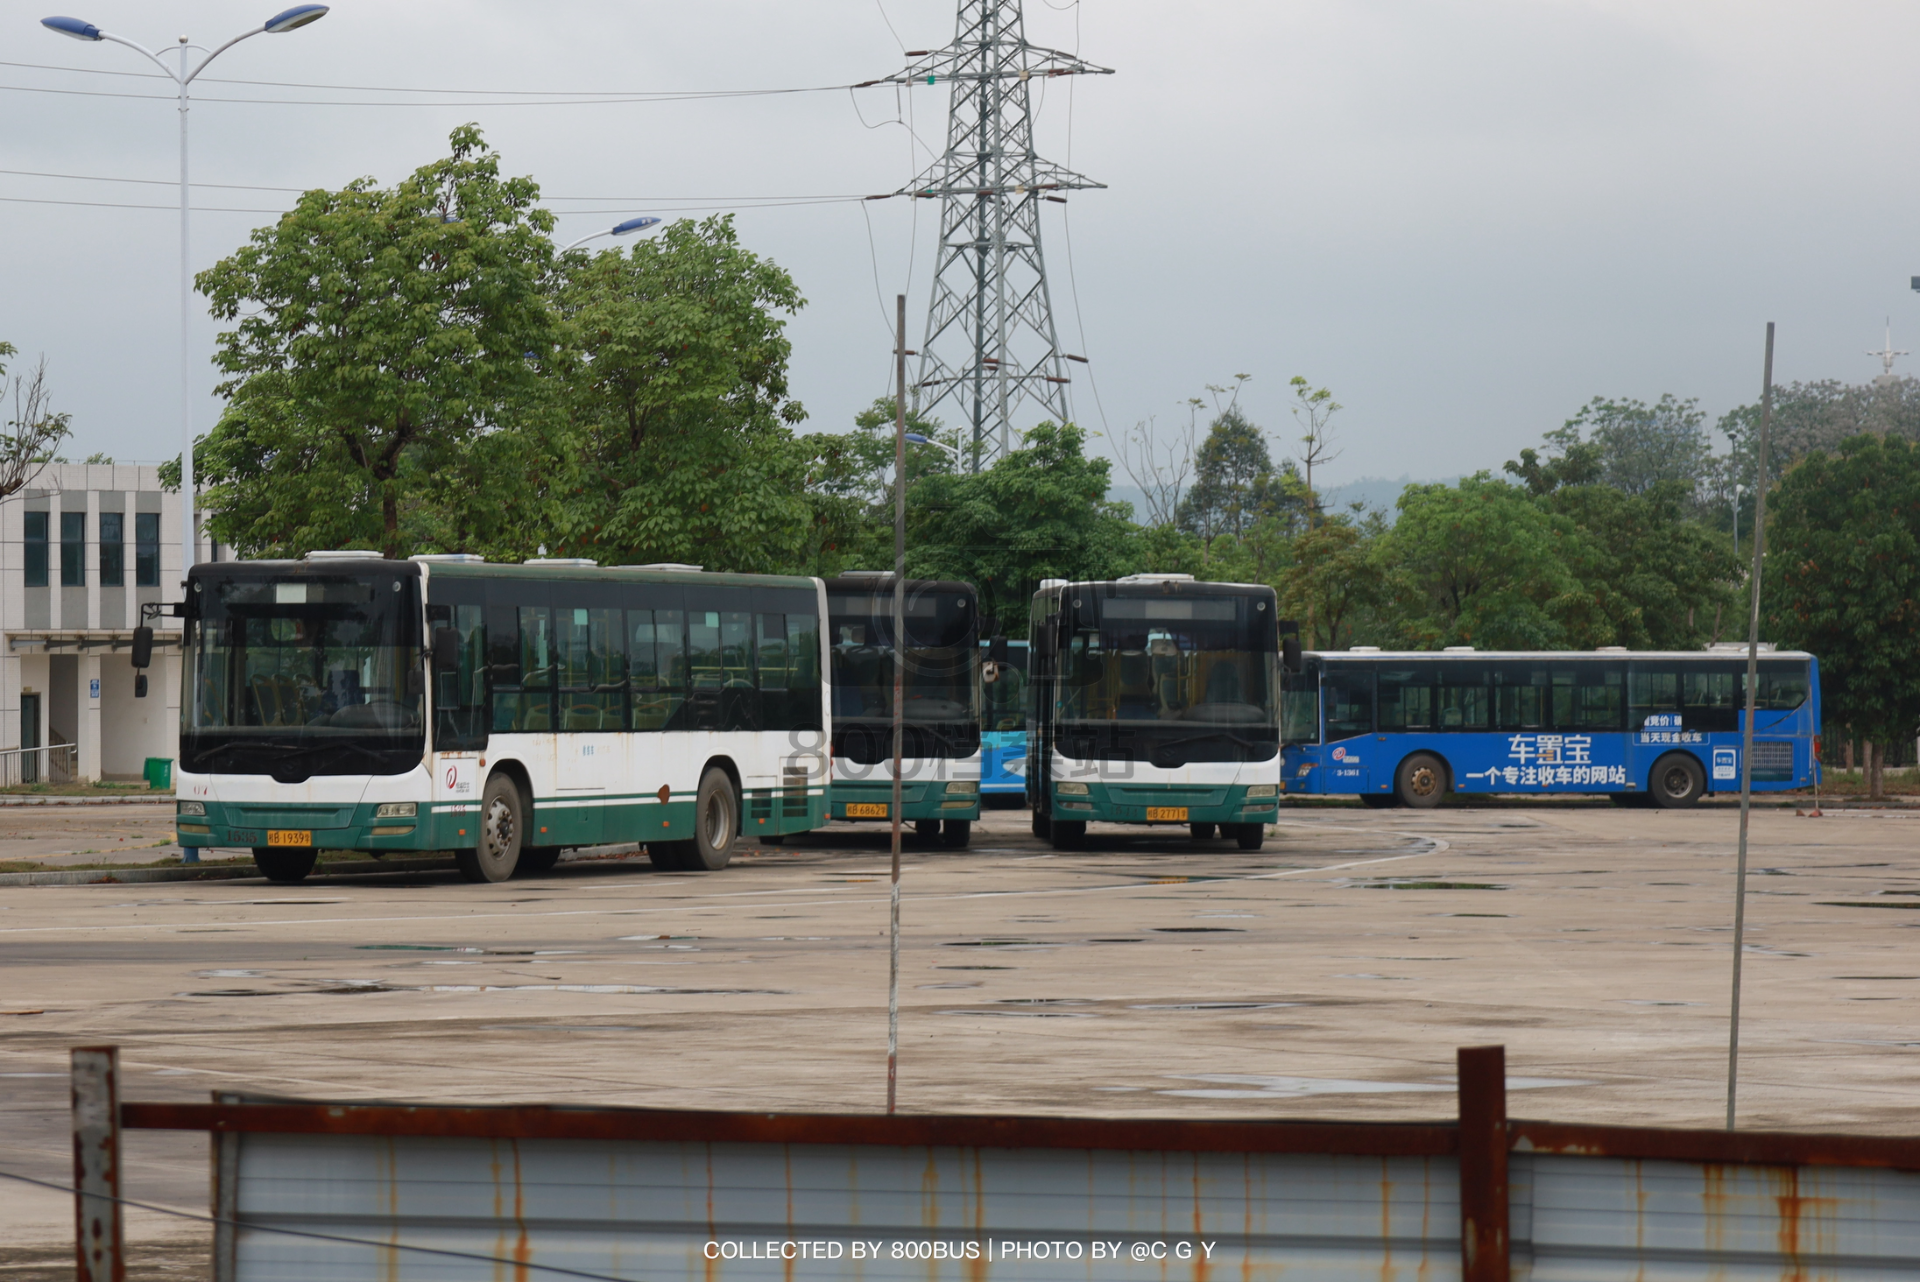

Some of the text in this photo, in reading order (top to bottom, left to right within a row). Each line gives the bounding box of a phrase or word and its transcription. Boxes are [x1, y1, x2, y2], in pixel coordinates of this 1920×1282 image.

[1640, 732, 1702, 743] 当天现金收车
[1508, 734, 1592, 764] 车置宝
[1466, 765, 1626, 785] 一个专注收车的网站
[227, 830, 258, 844] 1535
